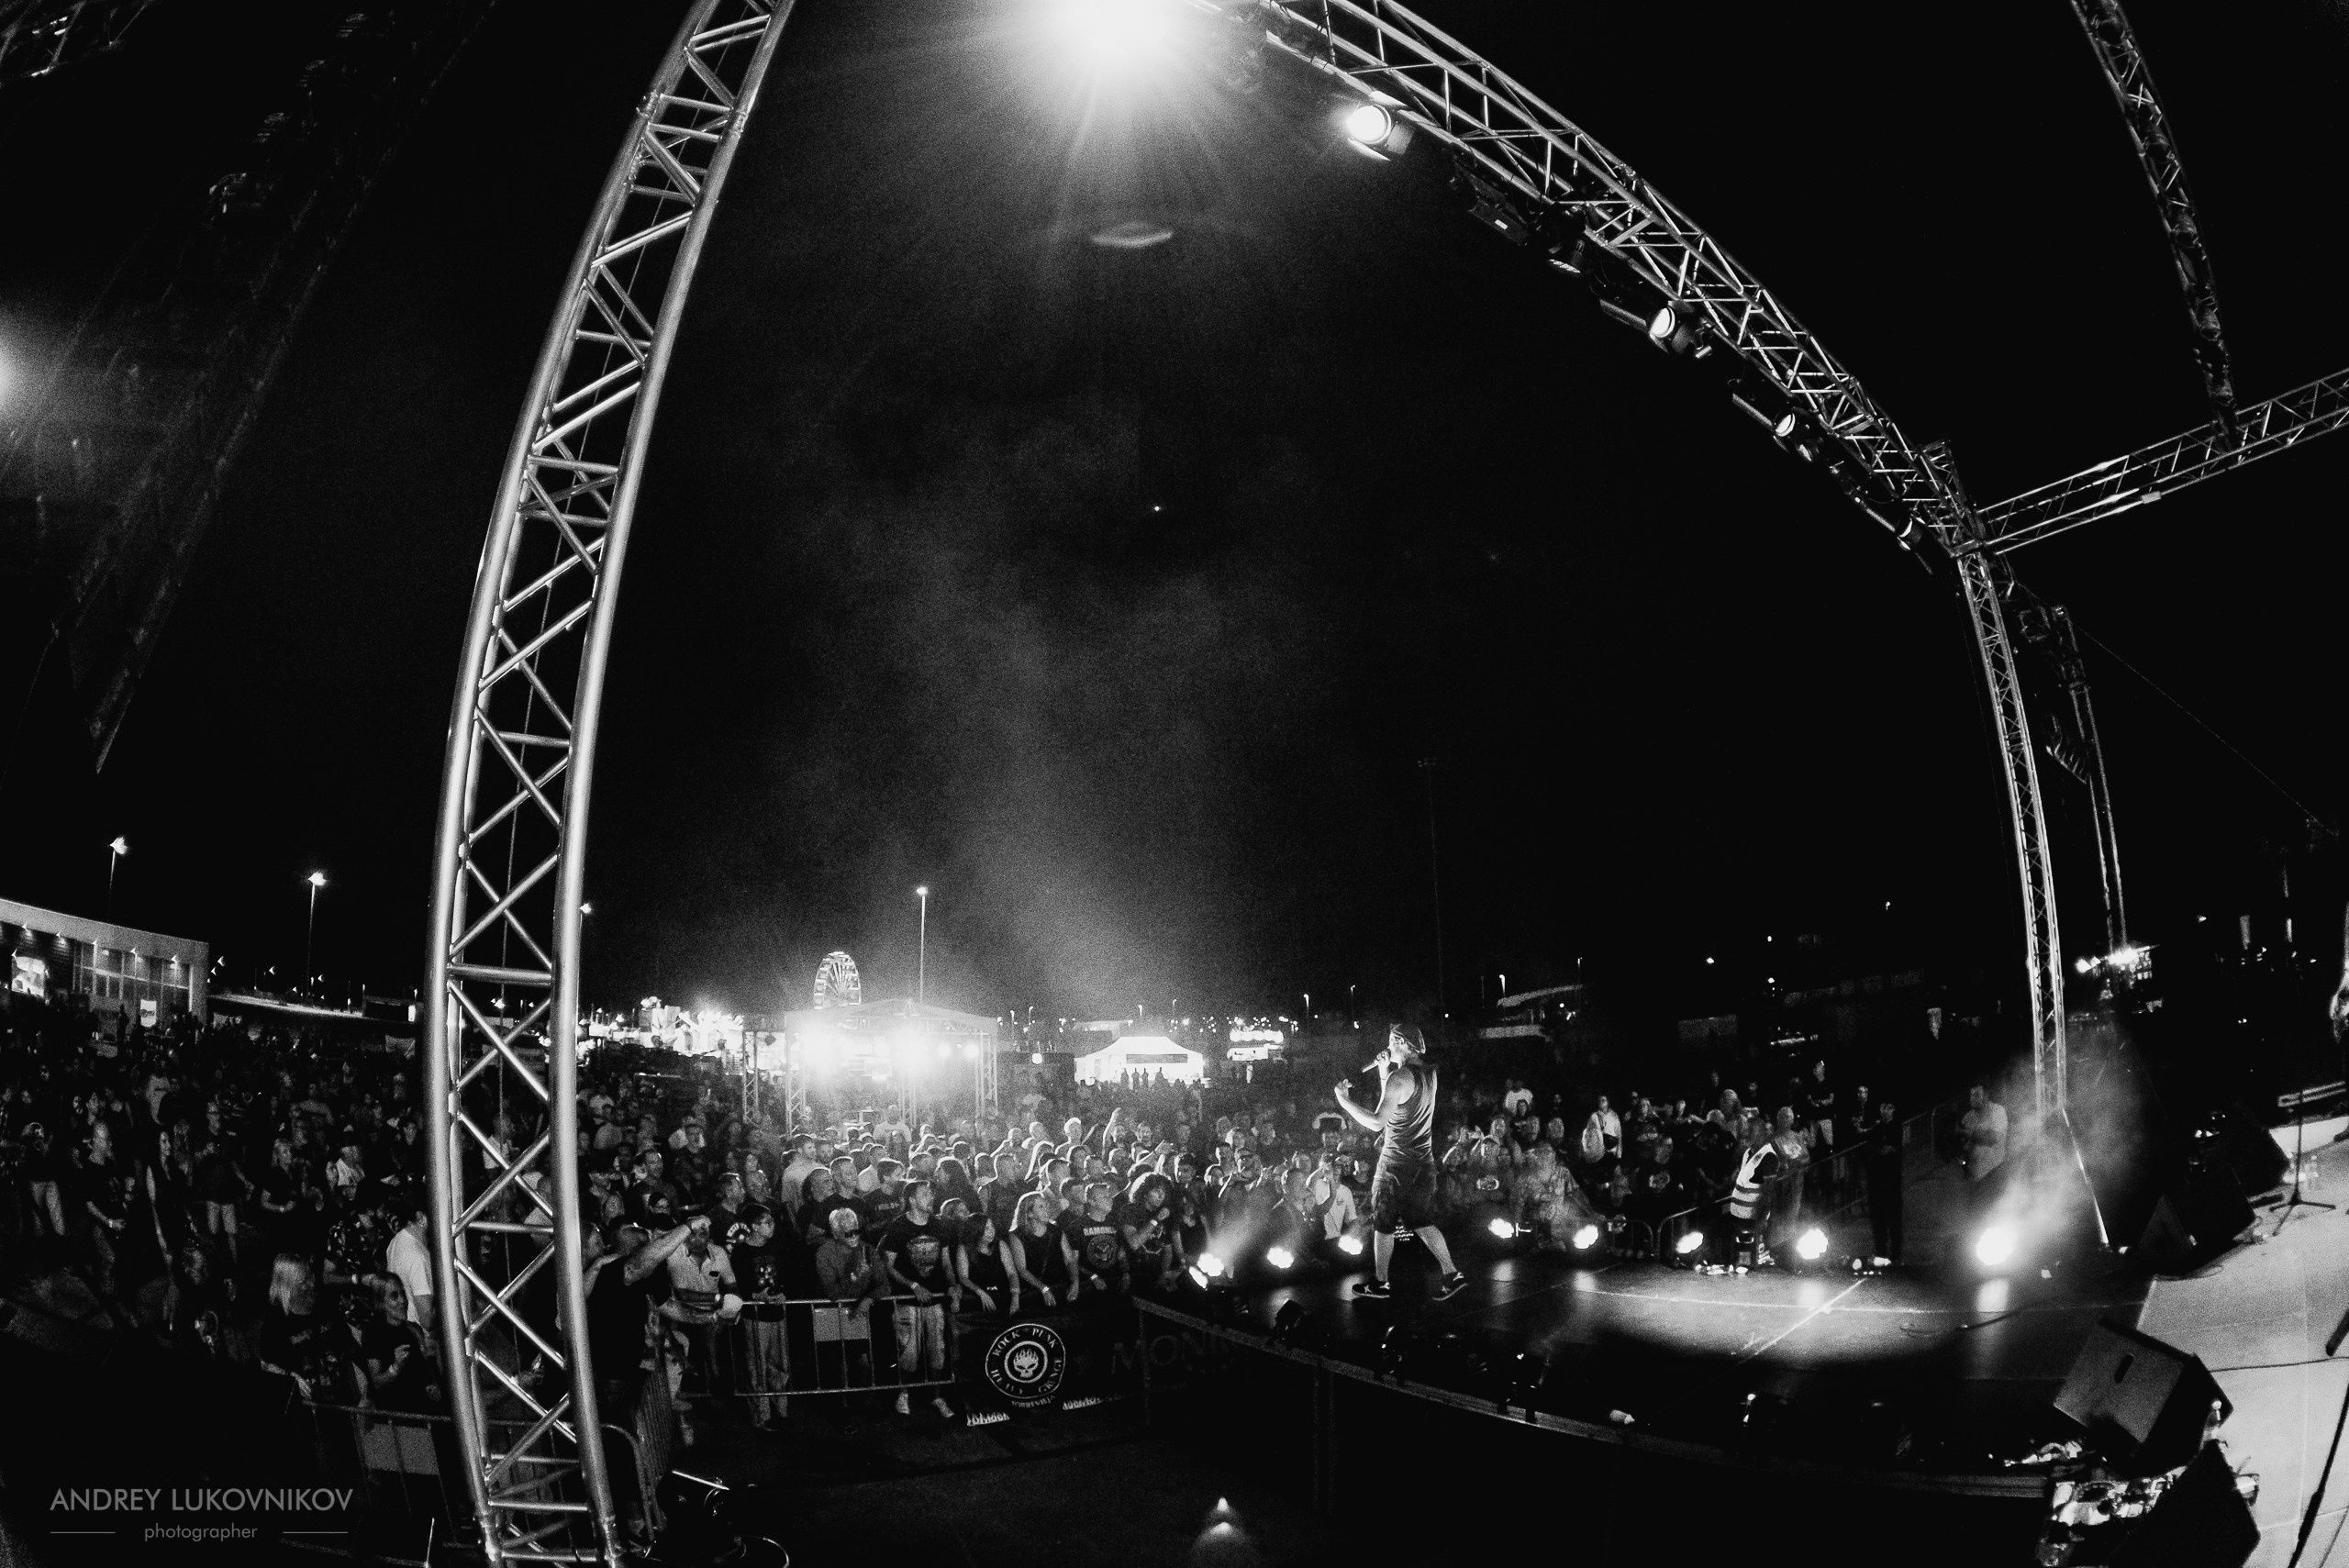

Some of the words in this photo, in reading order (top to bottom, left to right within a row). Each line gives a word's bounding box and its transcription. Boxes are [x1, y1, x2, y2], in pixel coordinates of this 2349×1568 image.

[992, 1329, 1020, 1357] ROCK
[1028, 1328, 1059, 1349] PUNK
[1038, 1357, 1063, 1393] GRUNGE
